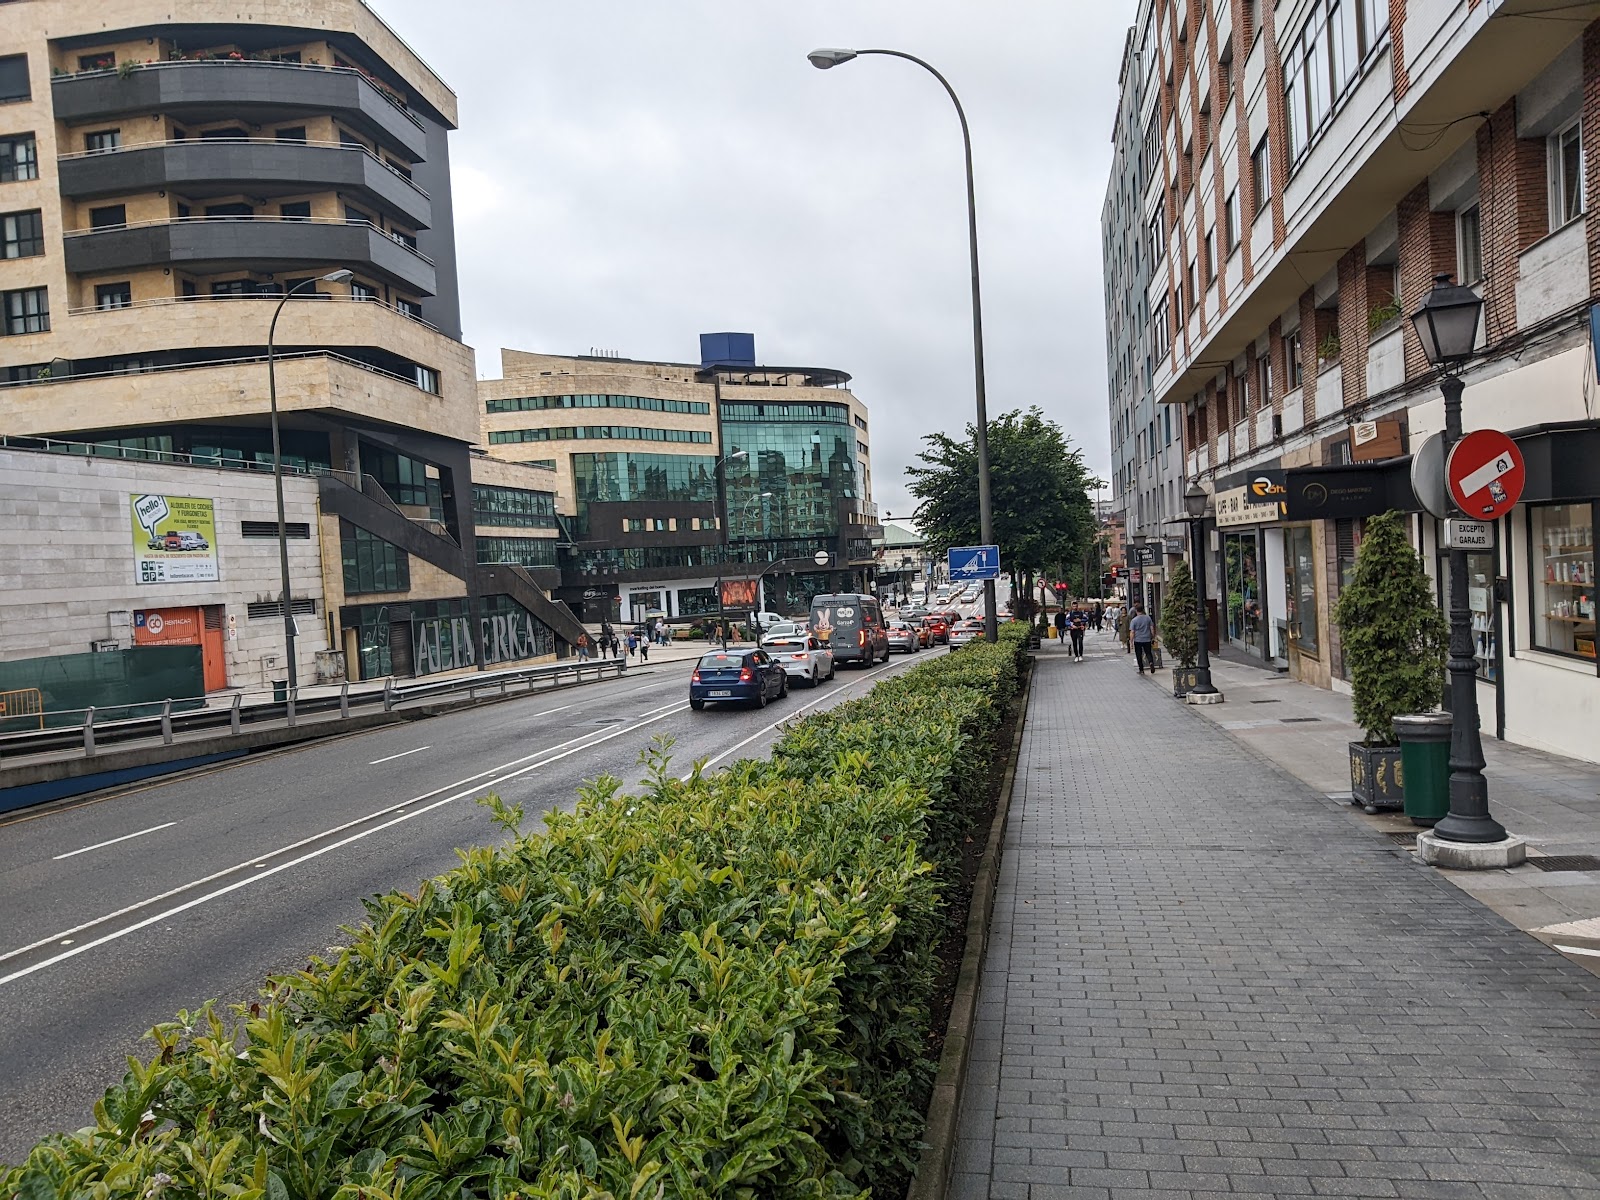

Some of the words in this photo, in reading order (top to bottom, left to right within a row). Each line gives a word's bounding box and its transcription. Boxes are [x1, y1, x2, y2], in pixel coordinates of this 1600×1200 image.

[1458, 524, 1485, 533] EXCEPTO
[1459, 536, 1486, 544] GARAJES
[136, 614, 144, 625] P
[149, 619, 162, 629] GO
